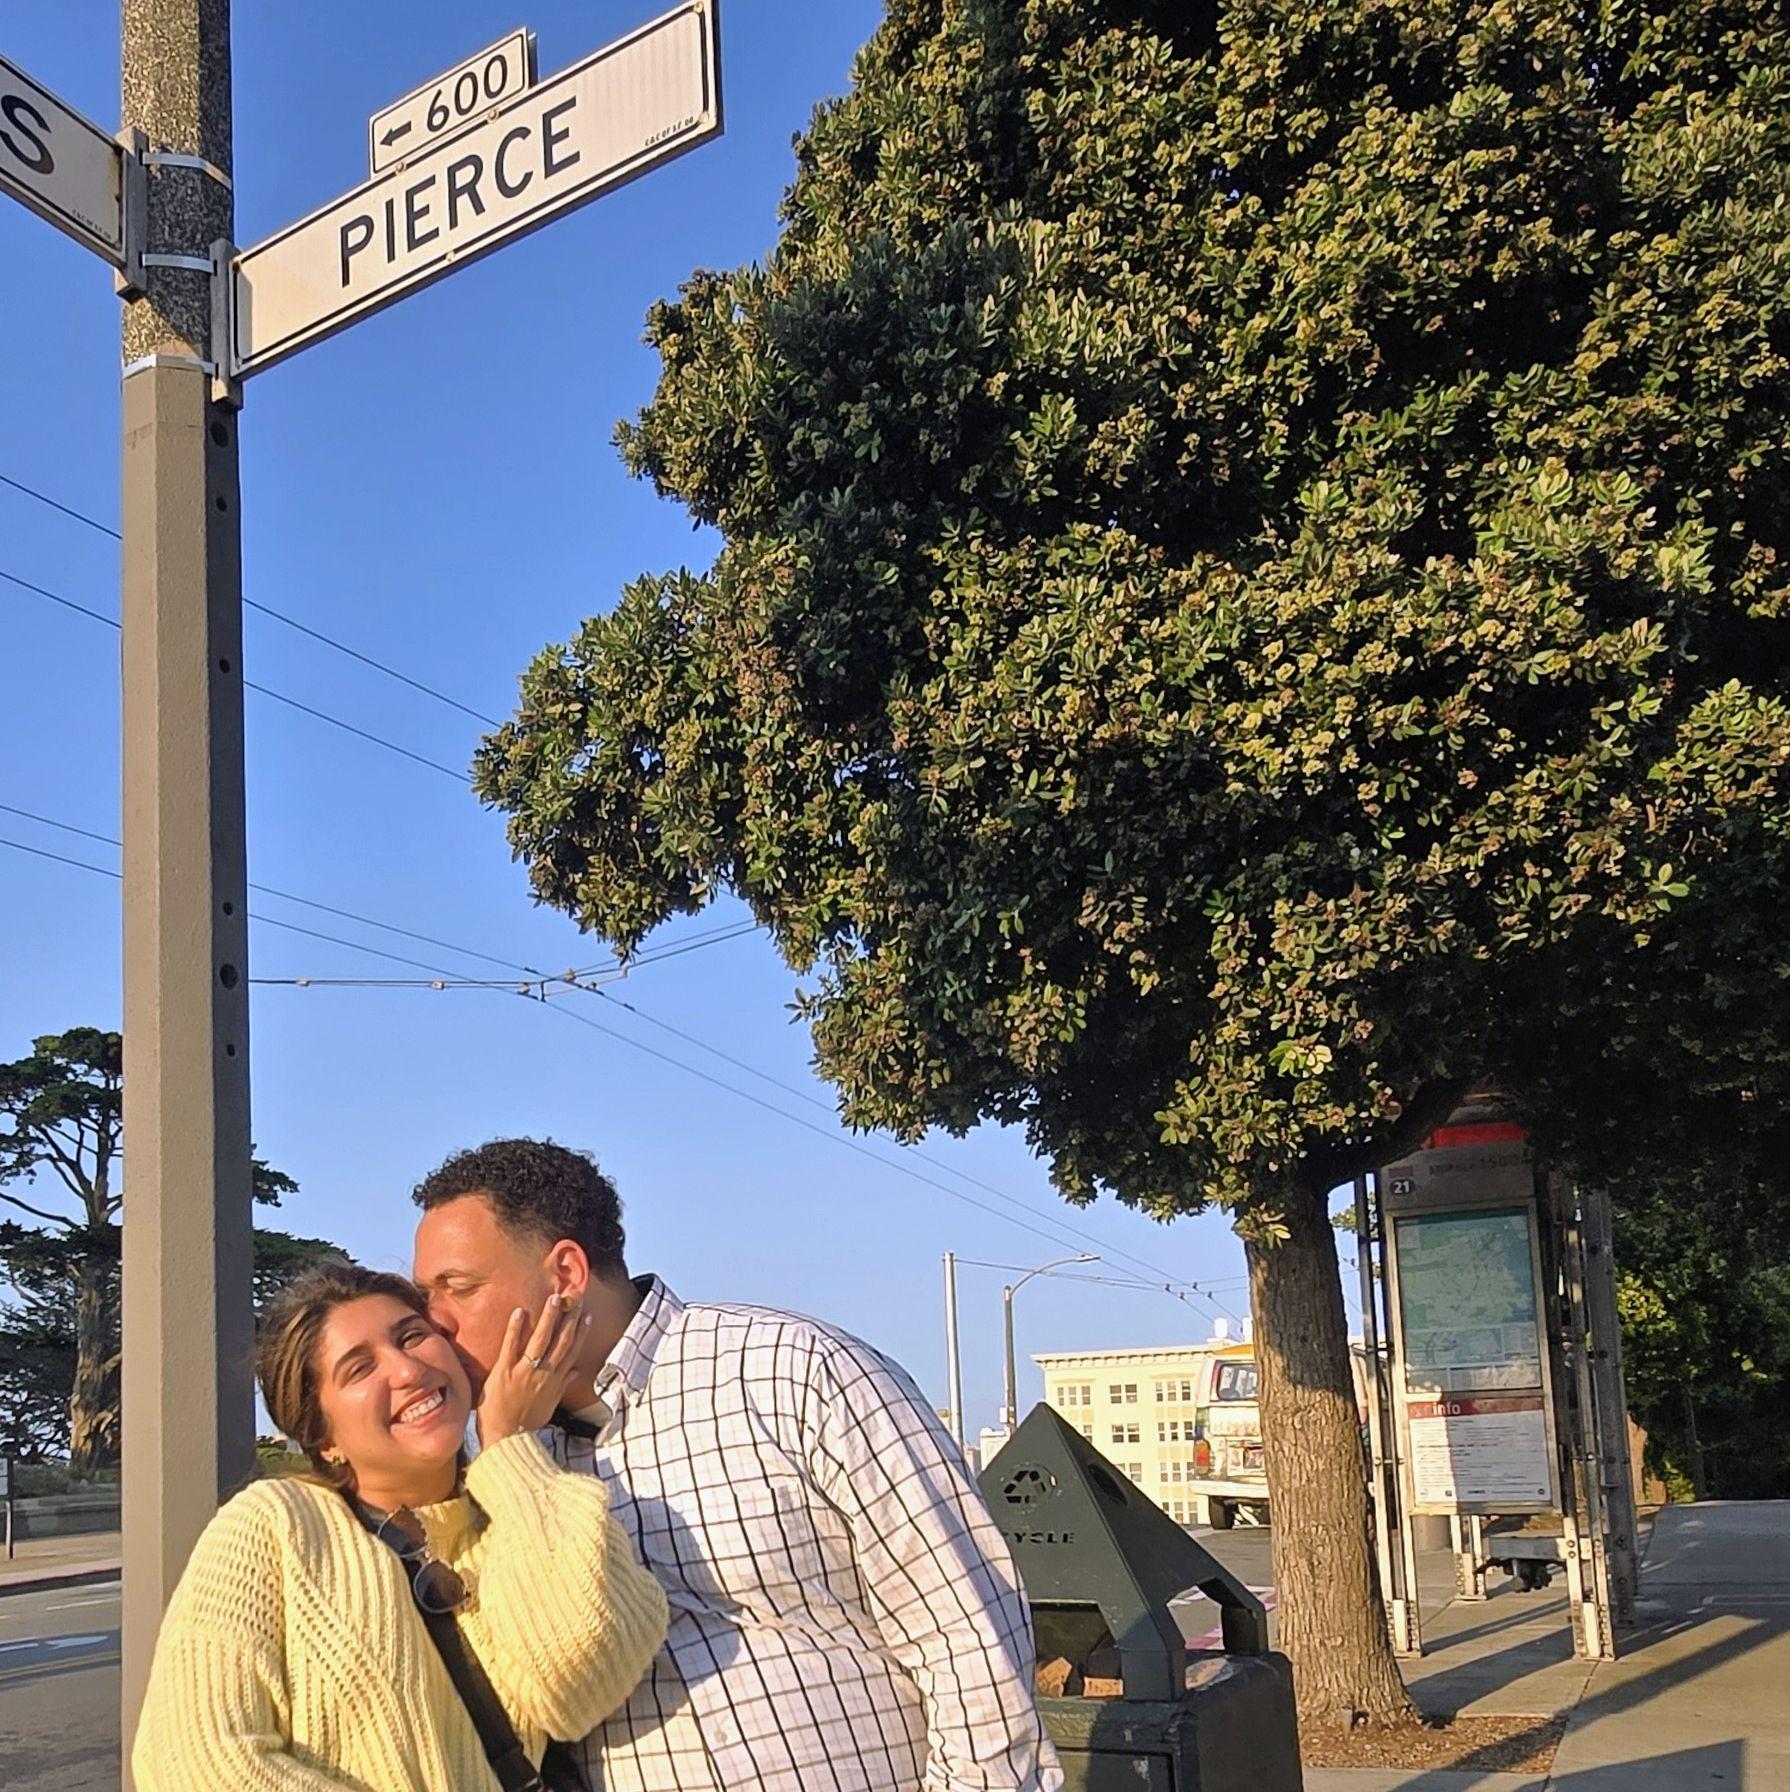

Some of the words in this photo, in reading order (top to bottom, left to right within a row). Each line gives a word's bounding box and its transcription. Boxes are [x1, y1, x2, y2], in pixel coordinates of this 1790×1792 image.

[427, 54, 507, 133] 600
[340, 95, 580, 288] PIERCE
[1394, 1180, 1409, 1194] 21
[1432, 1402, 1461, 1416] info
